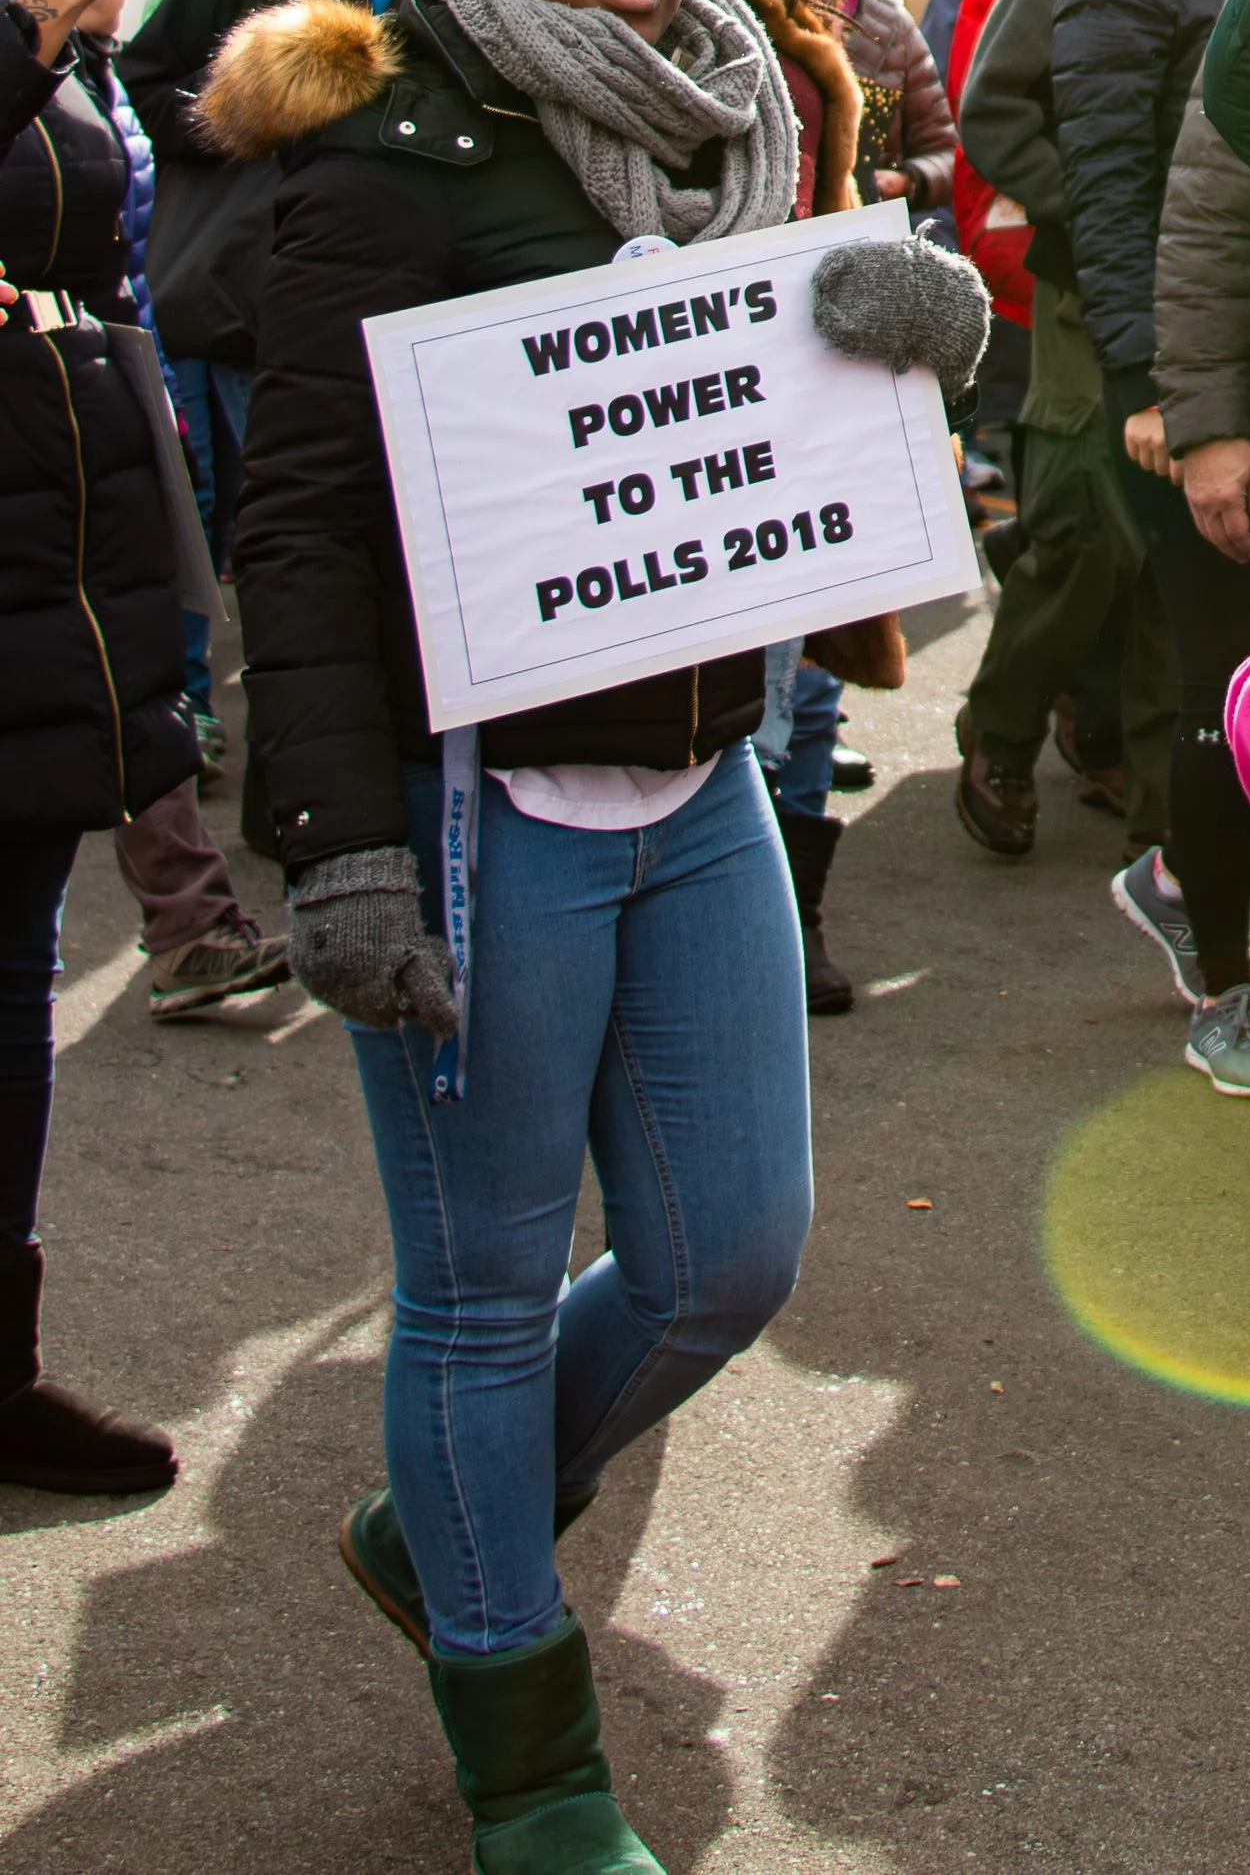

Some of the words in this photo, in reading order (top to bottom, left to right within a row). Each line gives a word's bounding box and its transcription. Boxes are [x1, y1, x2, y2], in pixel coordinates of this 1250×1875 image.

[521, 279, 778, 377] WOMEN'S
[568, 364, 767, 449] POWER
[582, 472, 656, 526] TO
[670, 439, 777, 502] THE
[535, 538, 710, 623] POLLS
[723, 501, 854, 572] 2018
